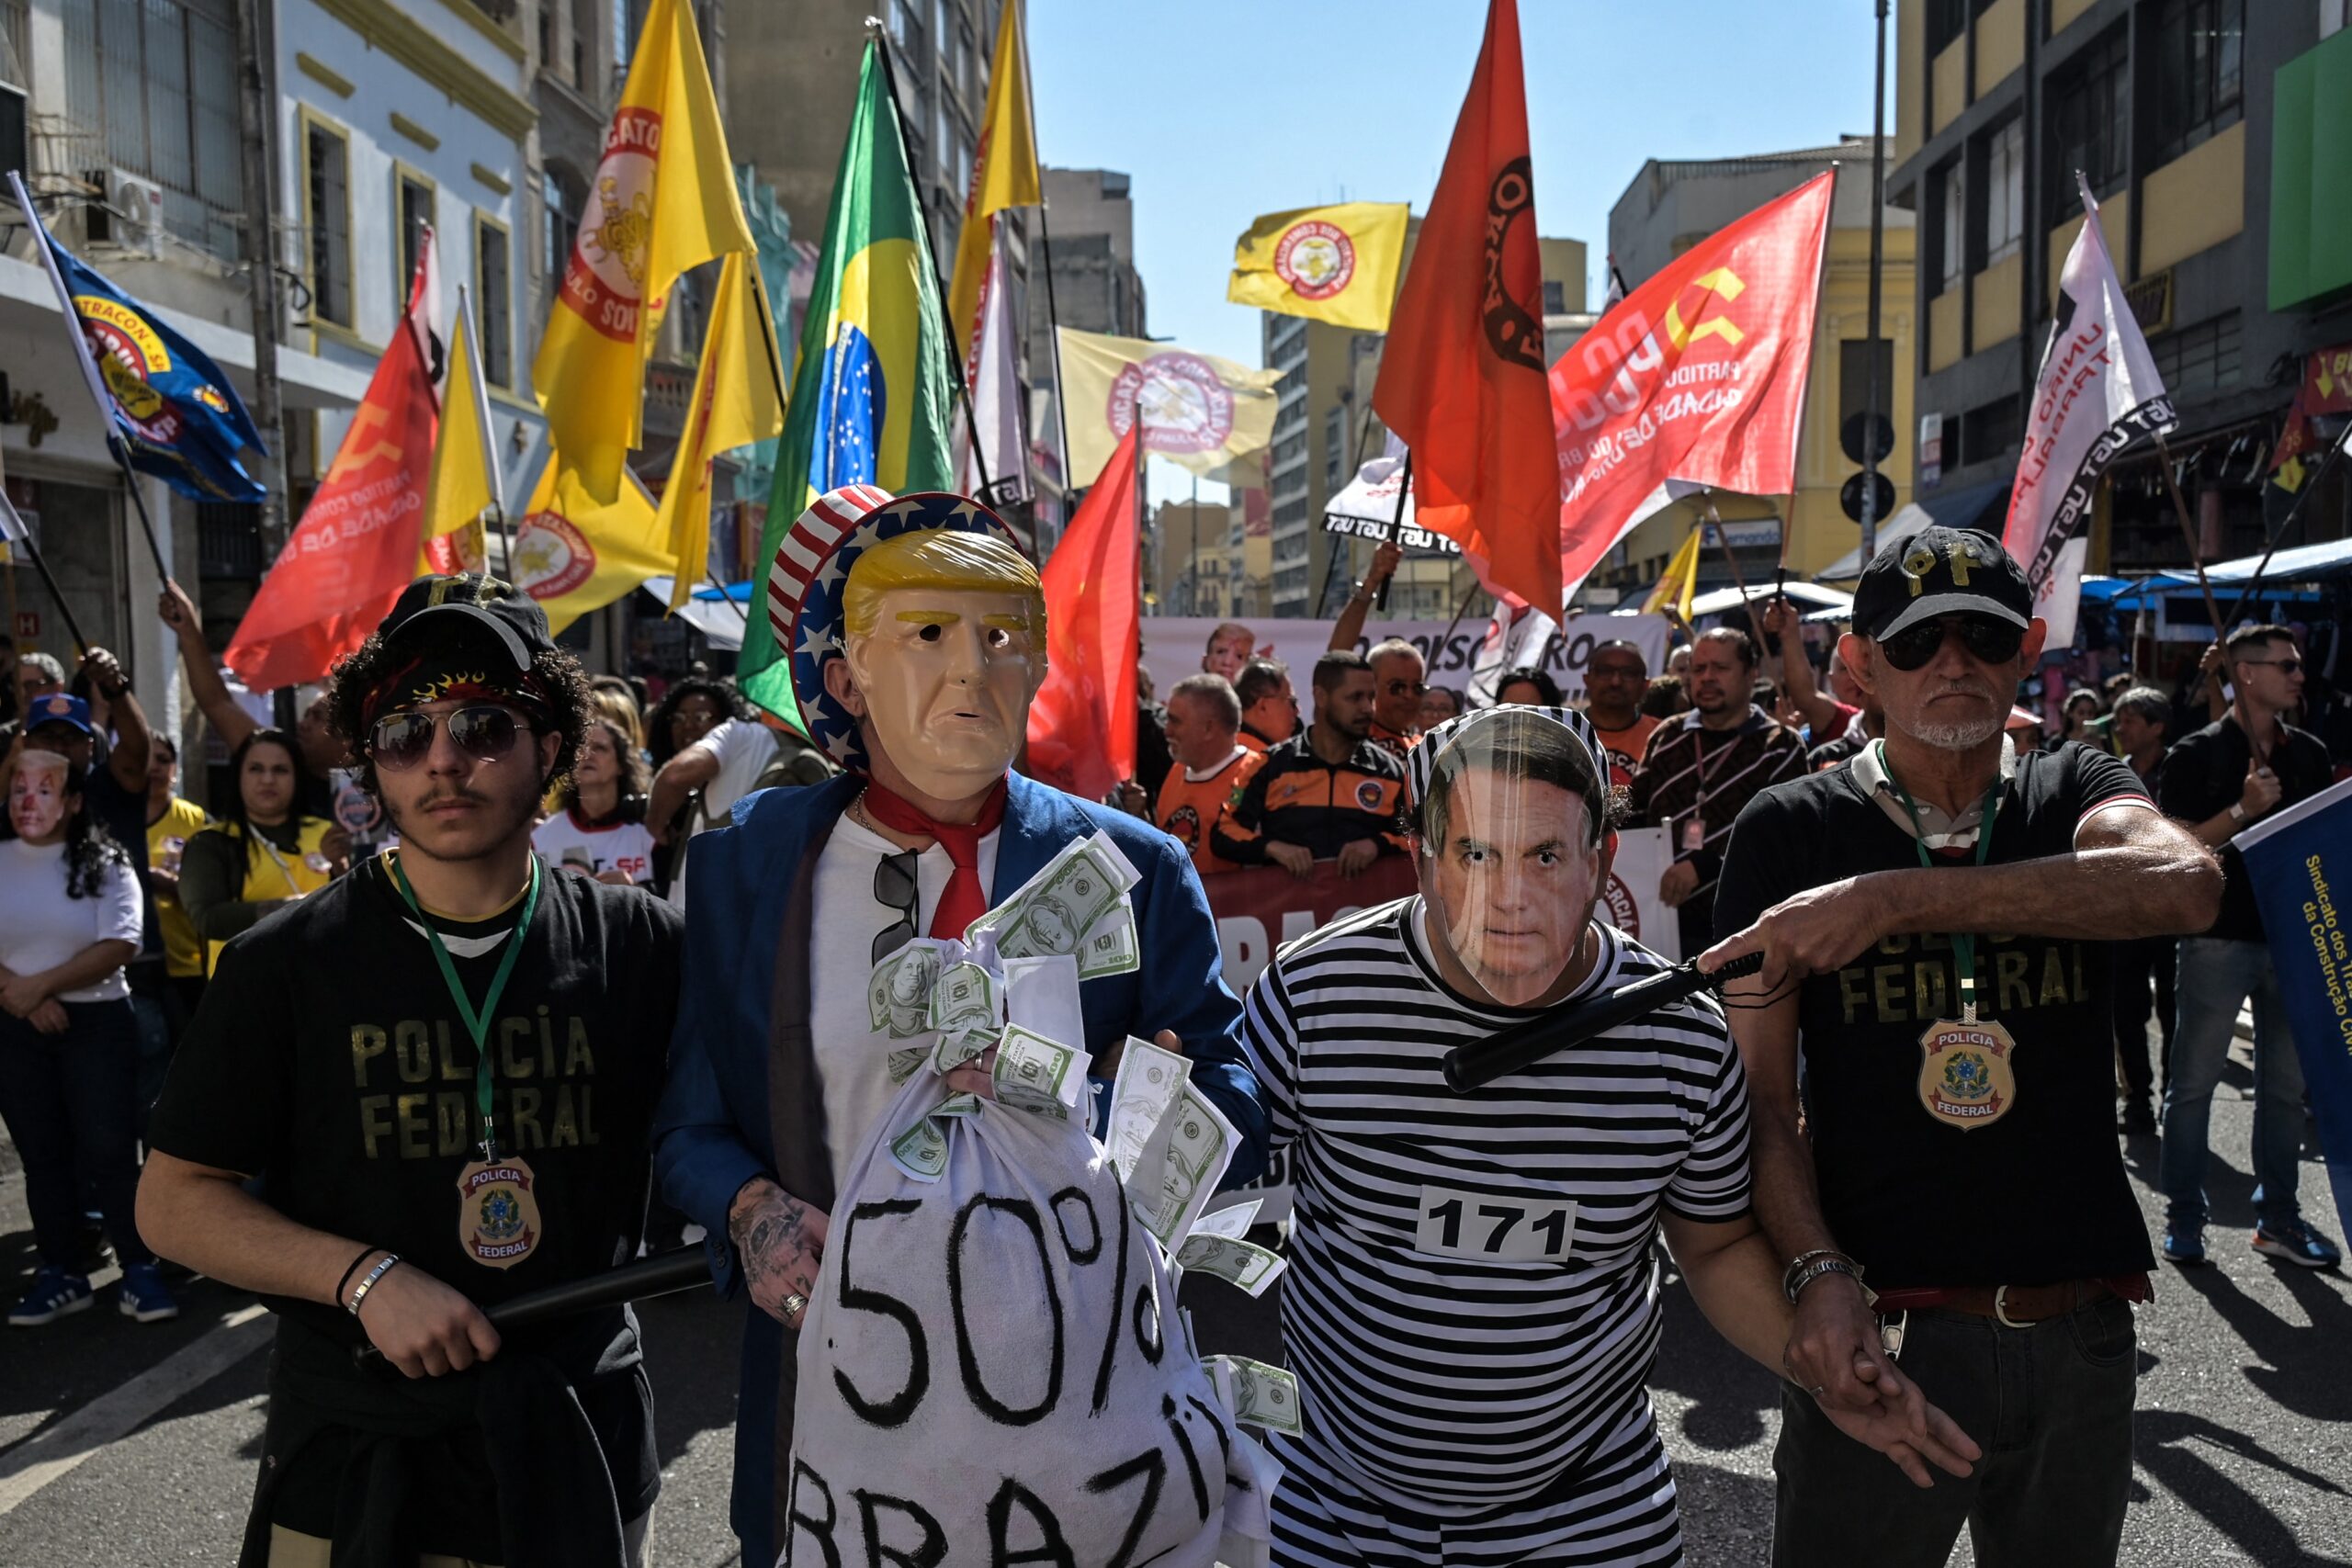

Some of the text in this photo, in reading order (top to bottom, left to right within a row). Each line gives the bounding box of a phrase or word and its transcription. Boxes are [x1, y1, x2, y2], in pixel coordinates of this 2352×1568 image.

[2306, 854, 2337, 928] Sindicato
[2330, 931, 2347, 960] dos
[2302, 901, 2317, 923] da
[2311, 923, 2347, 1016] Construção
[1937, 1100, 1994, 1117] FEDERAL
[478, 1240, 528, 1258] FEDERAL
[1428, 1198, 1567, 1256] 171
[833, 1159, 1165, 1428] 50%
